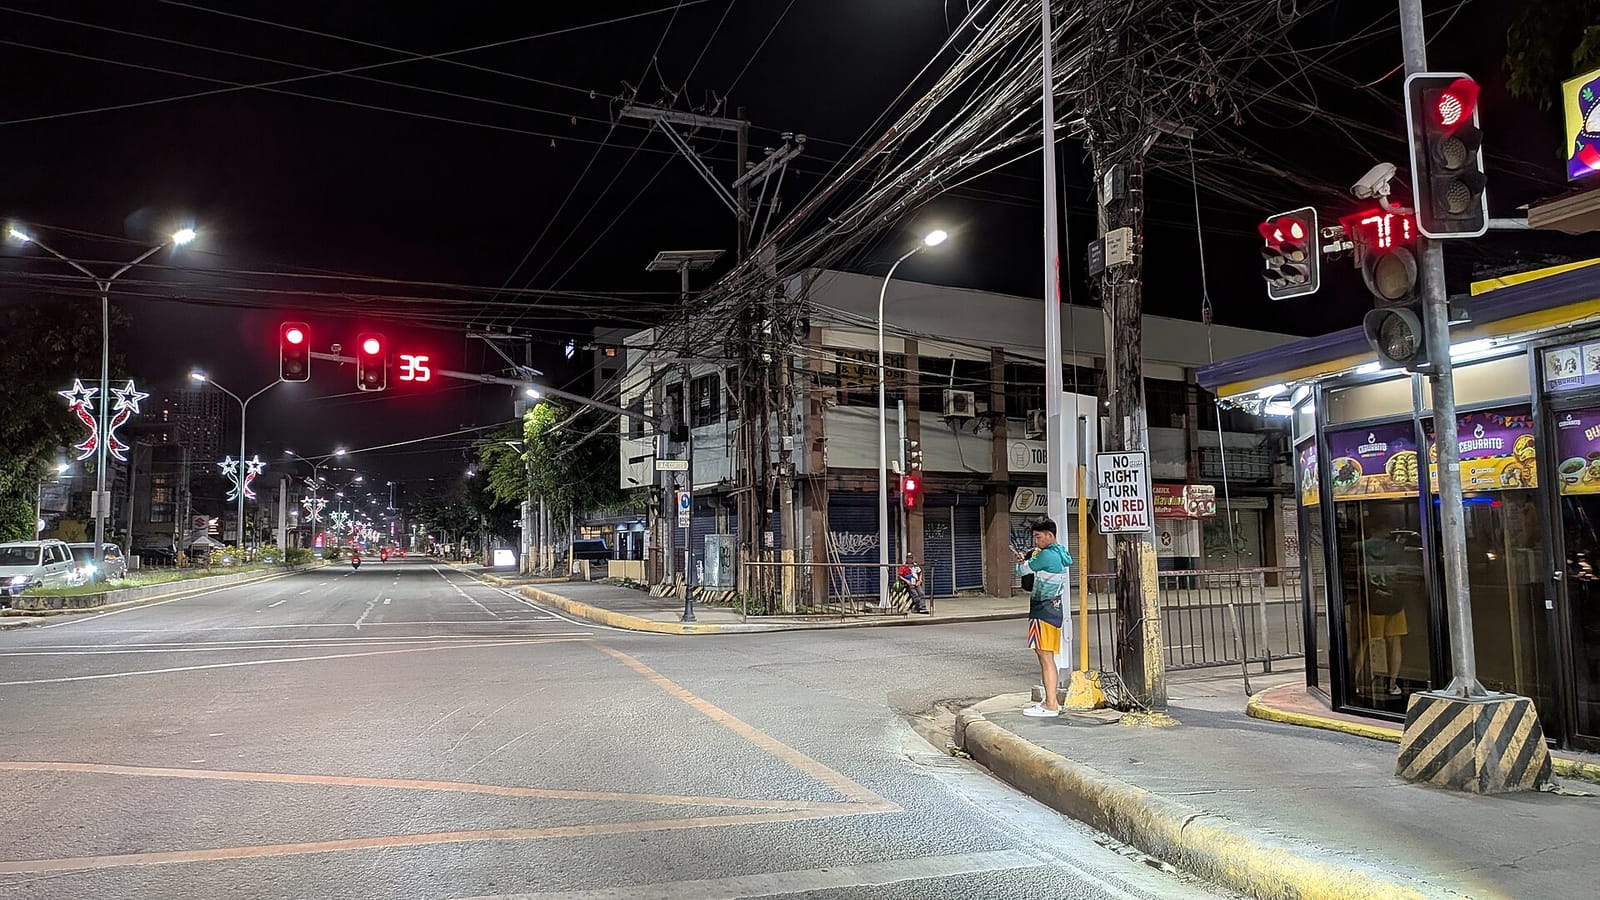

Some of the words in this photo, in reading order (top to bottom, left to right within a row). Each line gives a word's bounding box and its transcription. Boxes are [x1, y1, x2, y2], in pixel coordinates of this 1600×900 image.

[400, 355, 430, 381] 35
[1459, 438, 1503, 453] CEBURRITO
[1113, 456, 1129, 468] NO
[1104, 470, 1139, 483] RIGHT
[1109, 485, 1138, 497] TURN
[1103, 500, 1119, 513] ON
[1122, 500, 1145, 512] RED
[1103, 514, 1146, 527] SIGNAL
